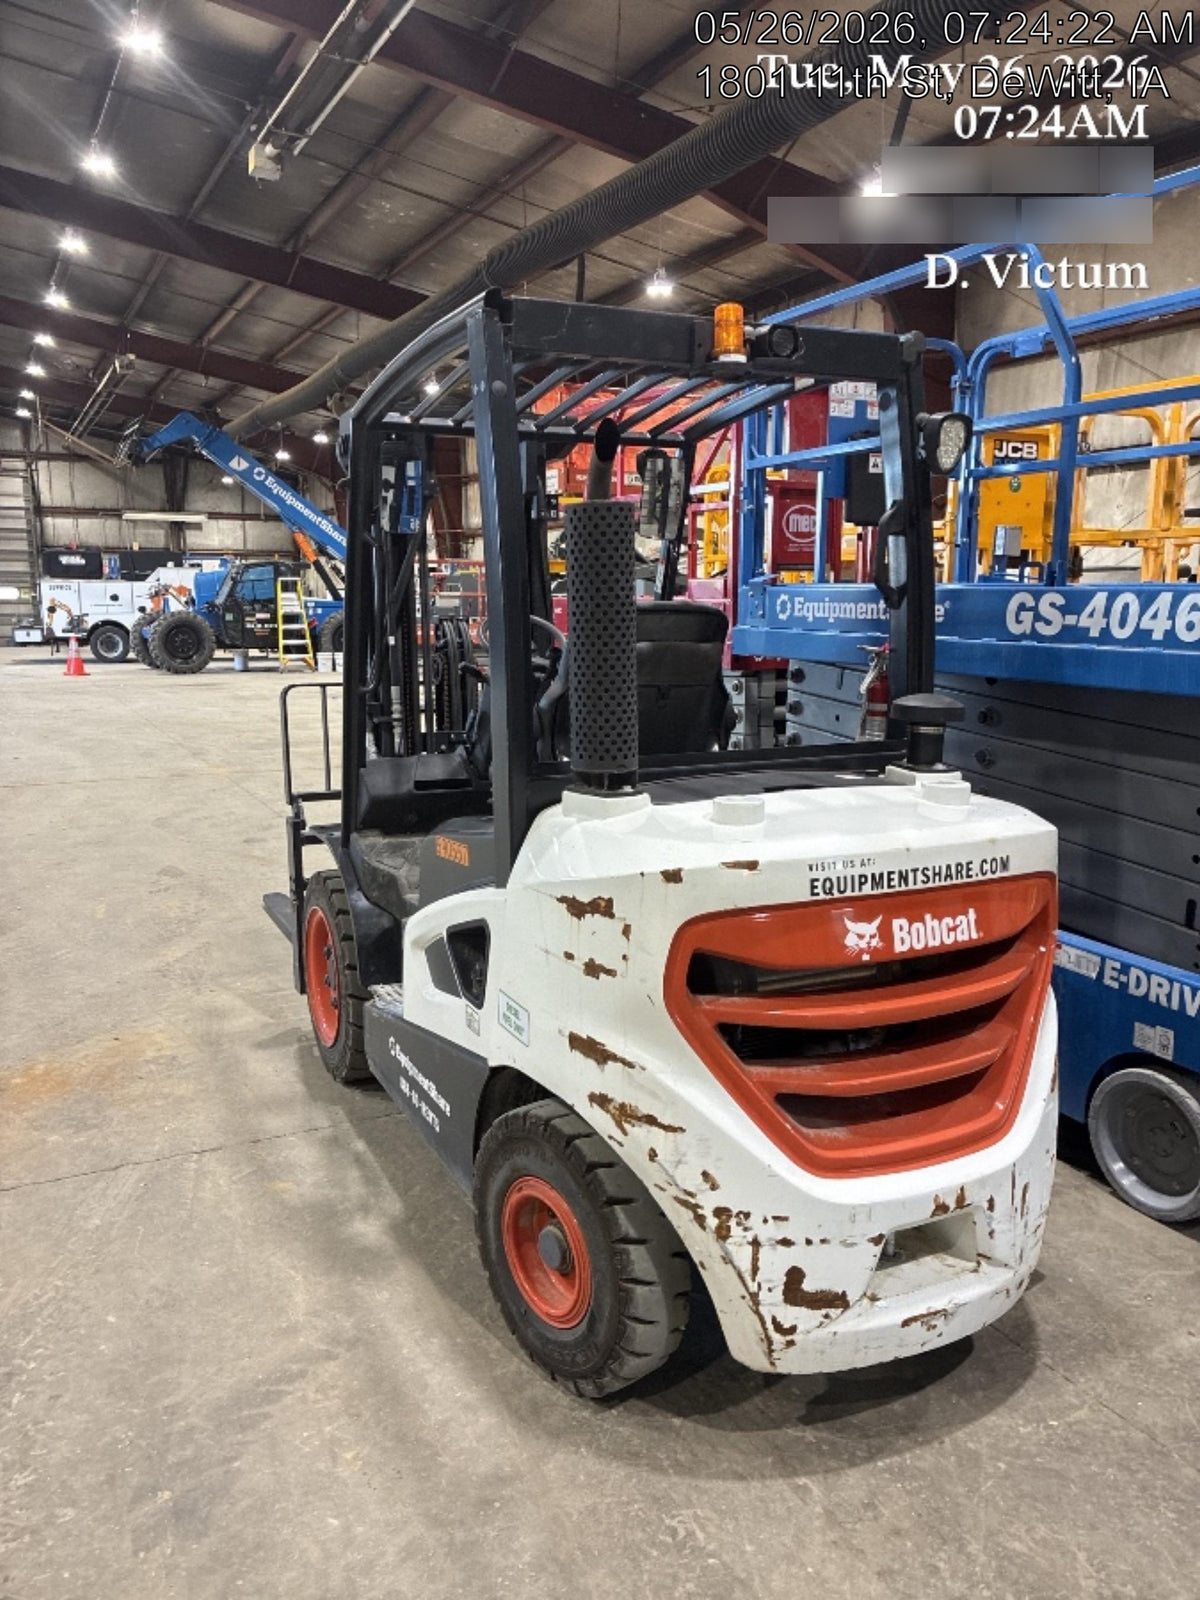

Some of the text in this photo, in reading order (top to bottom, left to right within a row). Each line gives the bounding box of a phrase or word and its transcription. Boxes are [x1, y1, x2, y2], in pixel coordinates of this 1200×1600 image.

[994, 441, 1038, 459] JCB
[264, 475, 347, 547] EquipmentShar
[793, 596, 946, 623] Equipmente
[1006, 591, 1200, 643] GS-4046
[809, 854, 1011, 897] EQUIPMENTSHARE.COM
[891, 907, 979, 953] Bobcat
[1103, 958, 1200, 1018] E-DRIV
